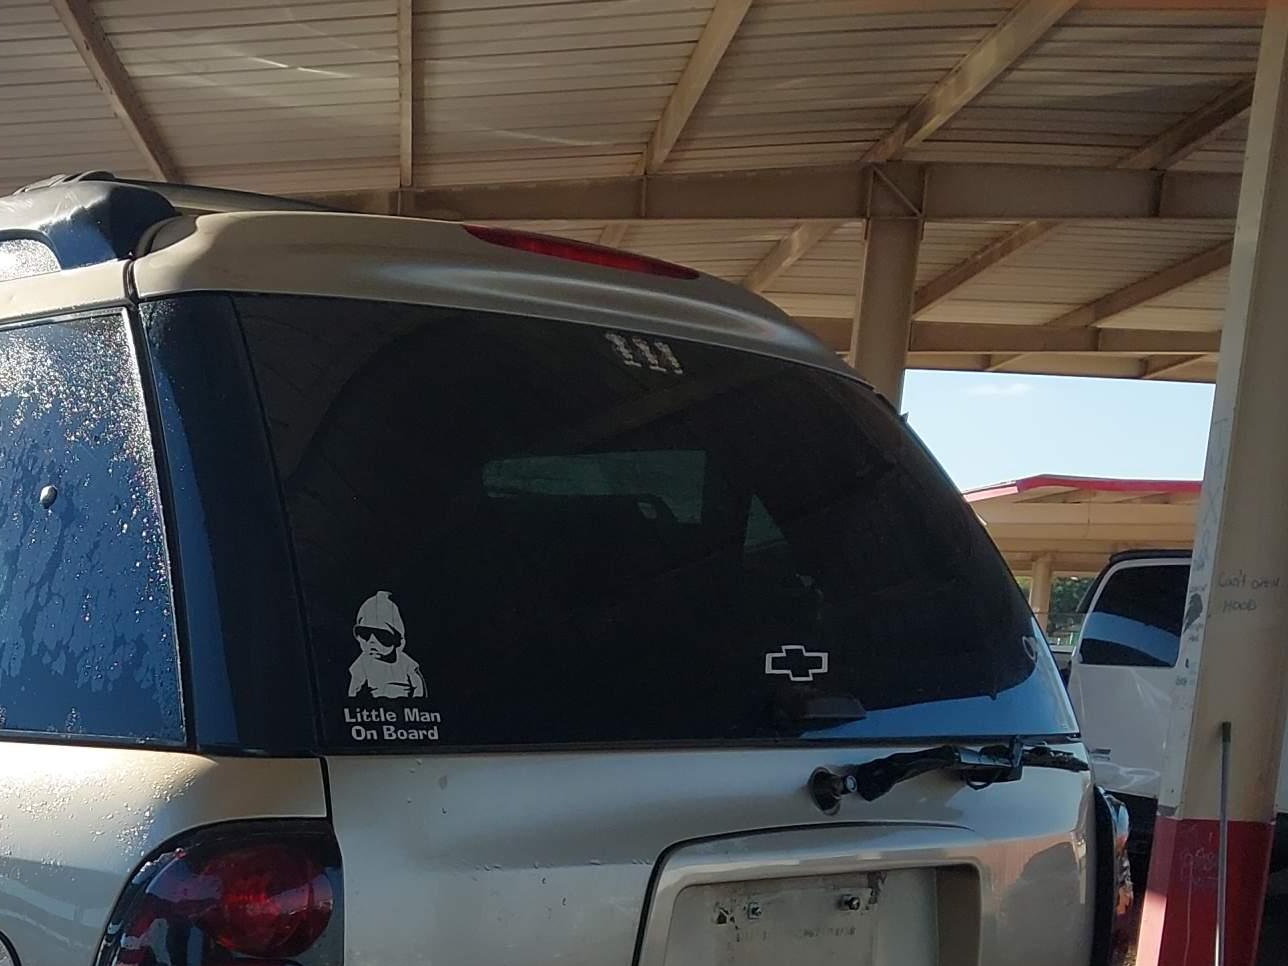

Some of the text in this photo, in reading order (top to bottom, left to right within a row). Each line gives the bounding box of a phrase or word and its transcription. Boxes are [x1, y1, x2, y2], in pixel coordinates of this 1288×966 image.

[344, 708, 441, 722] Little Man
[351, 726, 439, 740] On Board
